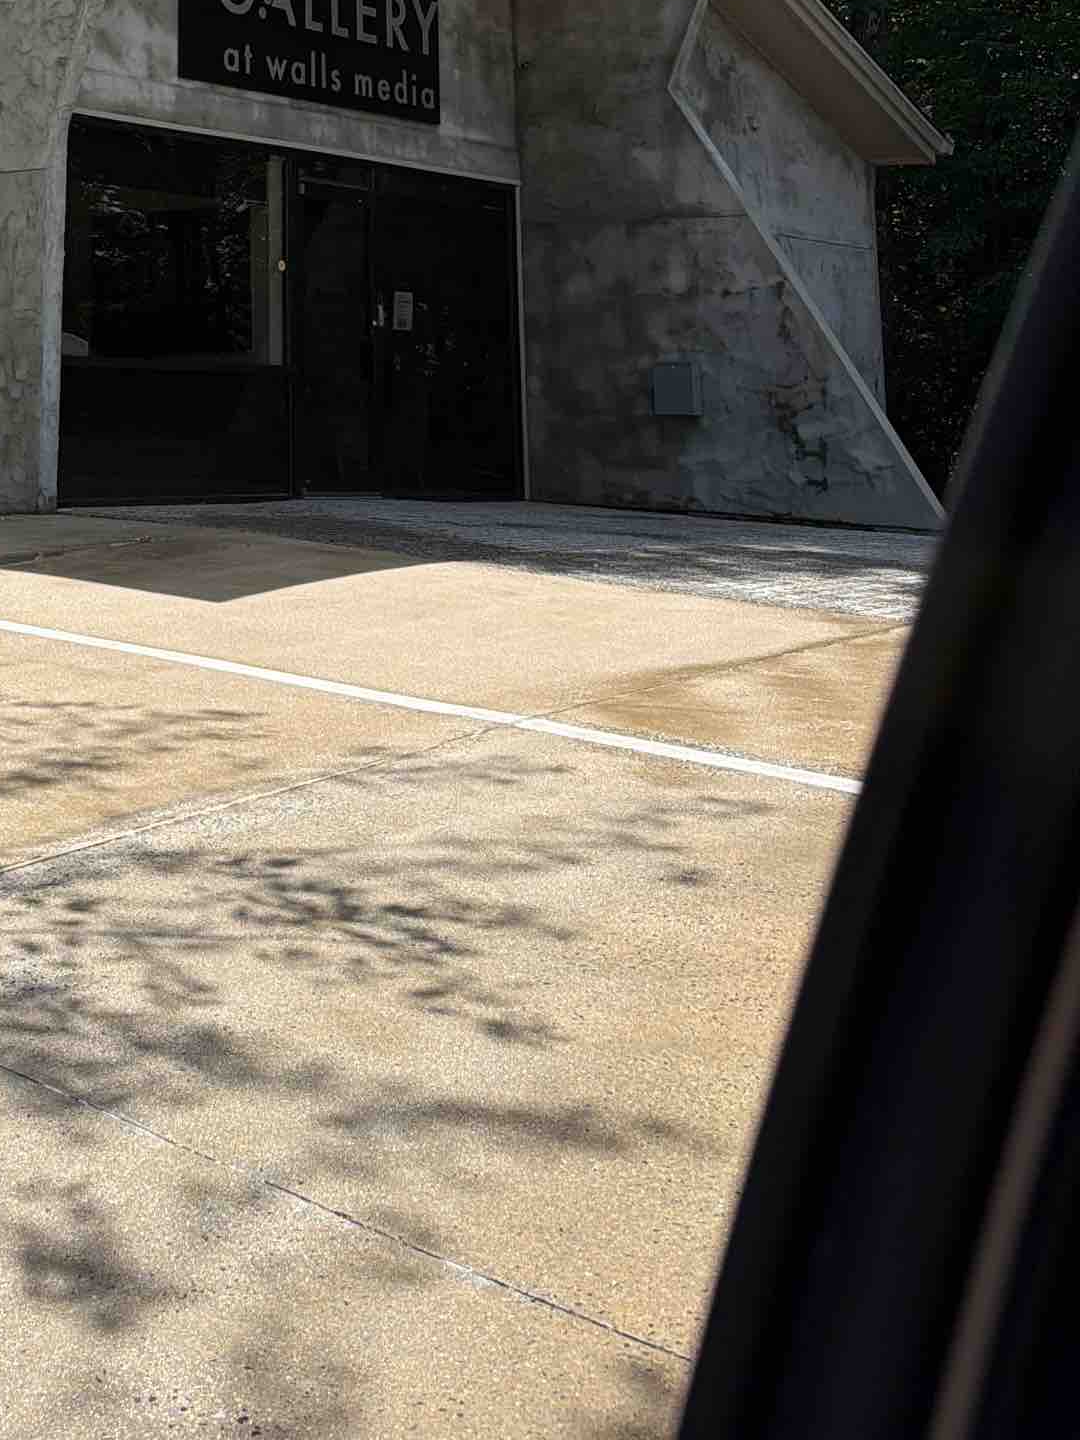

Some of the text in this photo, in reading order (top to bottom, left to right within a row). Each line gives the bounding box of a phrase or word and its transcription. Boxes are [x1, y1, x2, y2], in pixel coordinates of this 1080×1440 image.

[224, 45, 436, 109] at walls media
